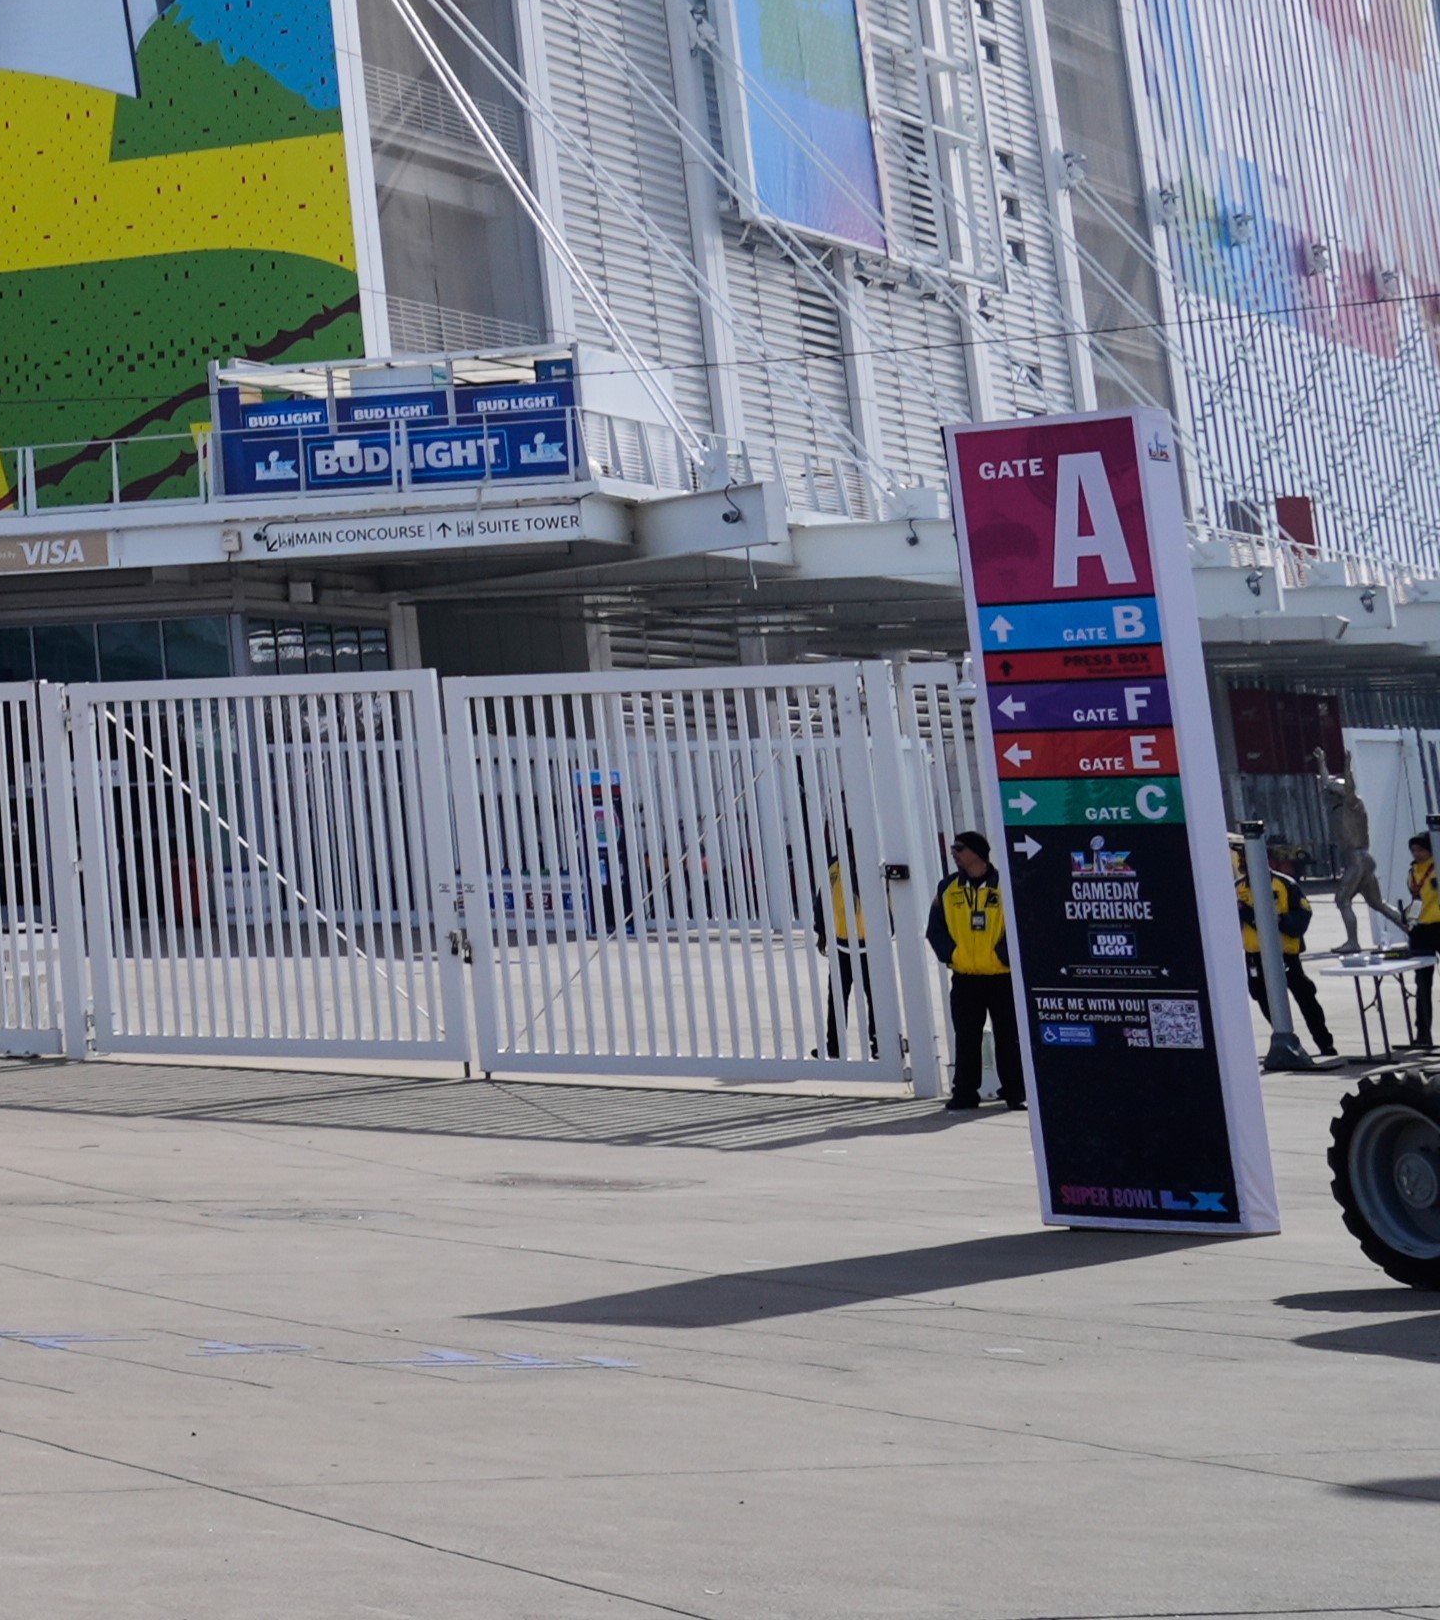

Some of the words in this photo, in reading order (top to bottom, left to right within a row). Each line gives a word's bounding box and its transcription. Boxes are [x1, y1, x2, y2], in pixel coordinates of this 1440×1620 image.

[354, 408, 383, 422] BUD
[385, 403, 430, 419] LIGHT
[476, 398, 507, 413] BUD
[508, 395, 556, 411] LIGHT
[248, 414, 279, 428] BUD
[280, 410, 322, 426] LIGHT
[315, 443, 390, 476] BUD
[404, 437, 500, 470] IGHT
[979, 458, 1044, 480] GATE
[1053, 451, 1137, 588] A
[295, 528, 333, 546] MAIN
[335, 525, 426, 544] CONCOURSE
[477, 519, 522, 535] SUITE
[525, 515, 580, 533] TOWER
[18, 539, 85, 565] VISA
[1062, 627, 1108, 642] GATE
[1112, 605, 1146, 639] B
[1063, 654, 1112, 667] PRESS
[1118, 652, 1149, 664] BOX
[1073, 708, 1118, 722] GATE
[1124, 686, 1151, 721] F
[1079, 757, 1125, 771] GATE
[1130, 735, 1160, 770] E
[1085, 806, 1131, 820] GATE
[1136, 784, 1168, 820] C
[1071, 882, 1140, 901] GAMEDAY
[1064, 902, 1154, 920] EXPERIENCE
[1096, 934, 1128, 945] BUD
[1092, 945, 1134, 956] LIGHT
[1076, 967, 1099, 975] OPEN
[1130, 968, 1152, 976] FANS
[1035, 997, 1065, 1011] TAKE
[1067, 998, 1085, 1011] ME
[1087, 998, 1116, 1011] WITH
[1118, 999, 1146, 1012] YOU!
[1038, 1011, 1063, 1020] Scan
[1066, 1011, 1079, 1021] for
[1082, 1013, 1122, 1023] campus
[1124, 1014, 1147, 1023] map
[1127, 1037, 1151, 1047] PASS
[1061, 1185, 1110, 1207] SUPER
[1113, 1188, 1158, 1209] BOWL
[1160, 1190, 1229, 1212] LX
